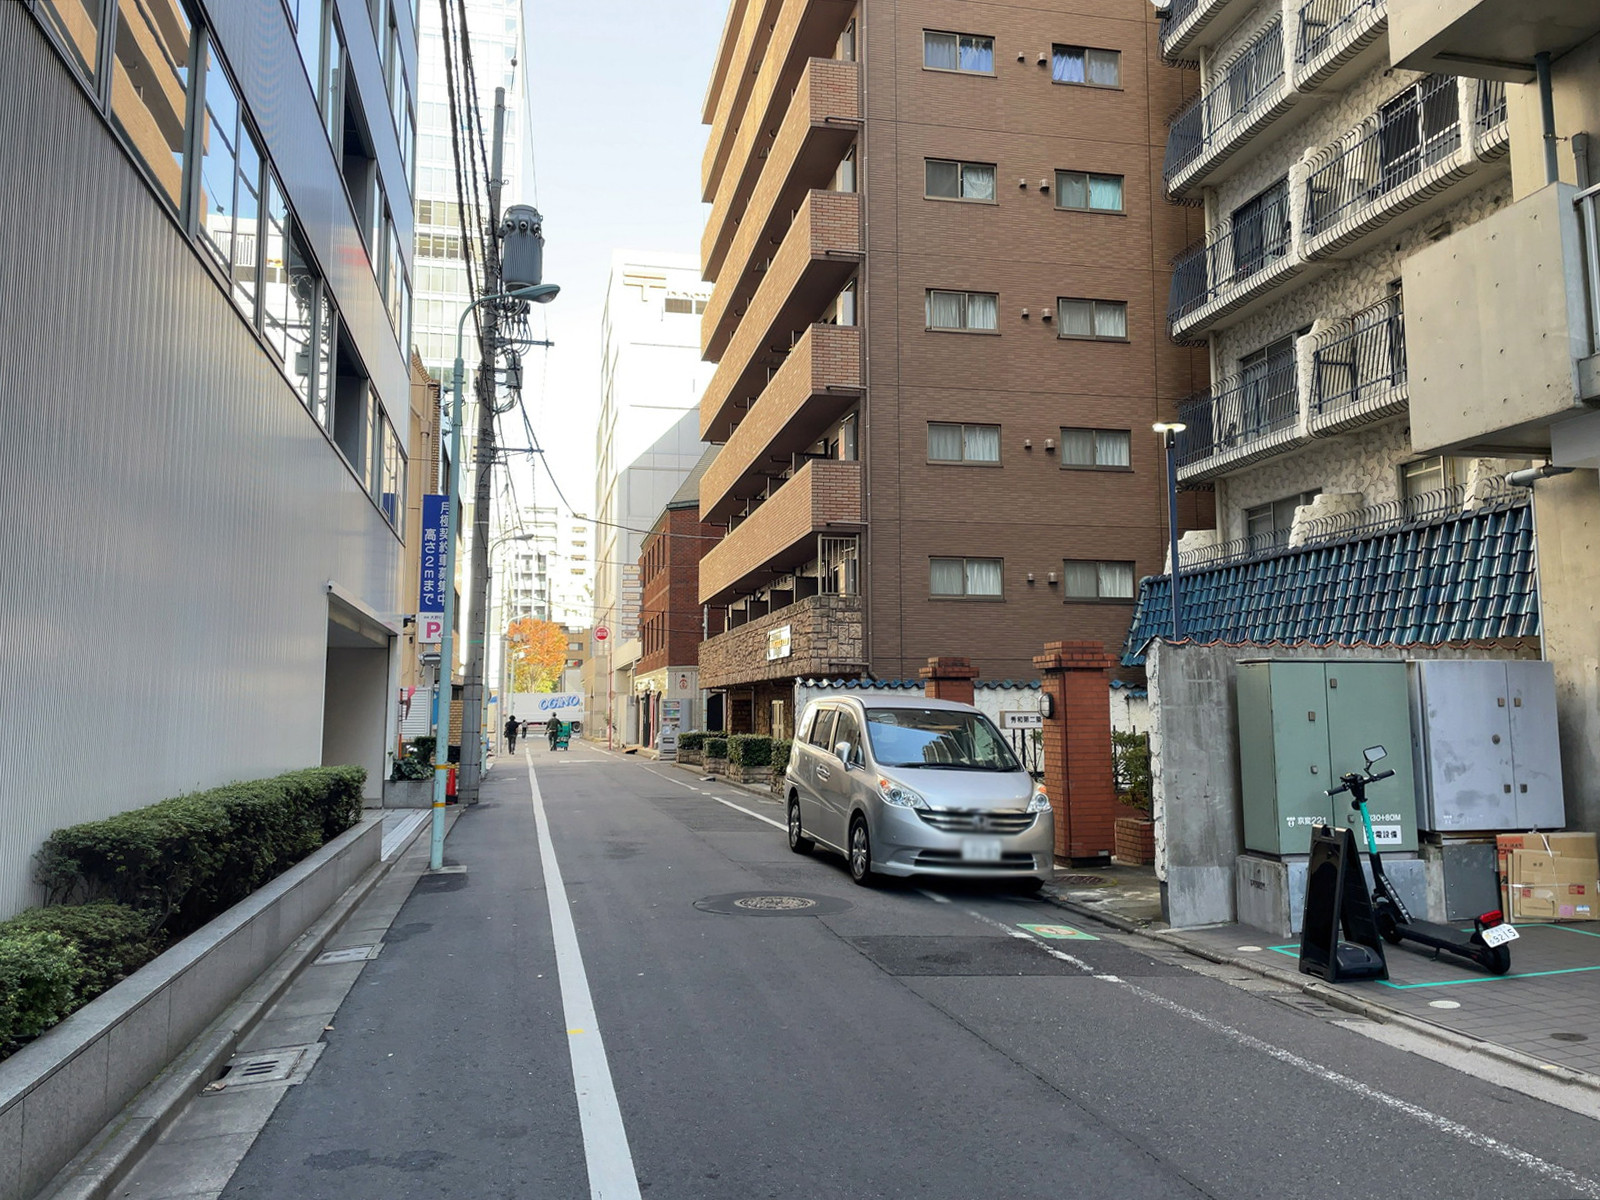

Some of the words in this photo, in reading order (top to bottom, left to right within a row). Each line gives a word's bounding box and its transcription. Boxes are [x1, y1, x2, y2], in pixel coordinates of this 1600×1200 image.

[423, 528, 437, 605] 高さ2mまで
[426, 621, 441, 639] P
[1372, 830, 1398, 840] 電設備
